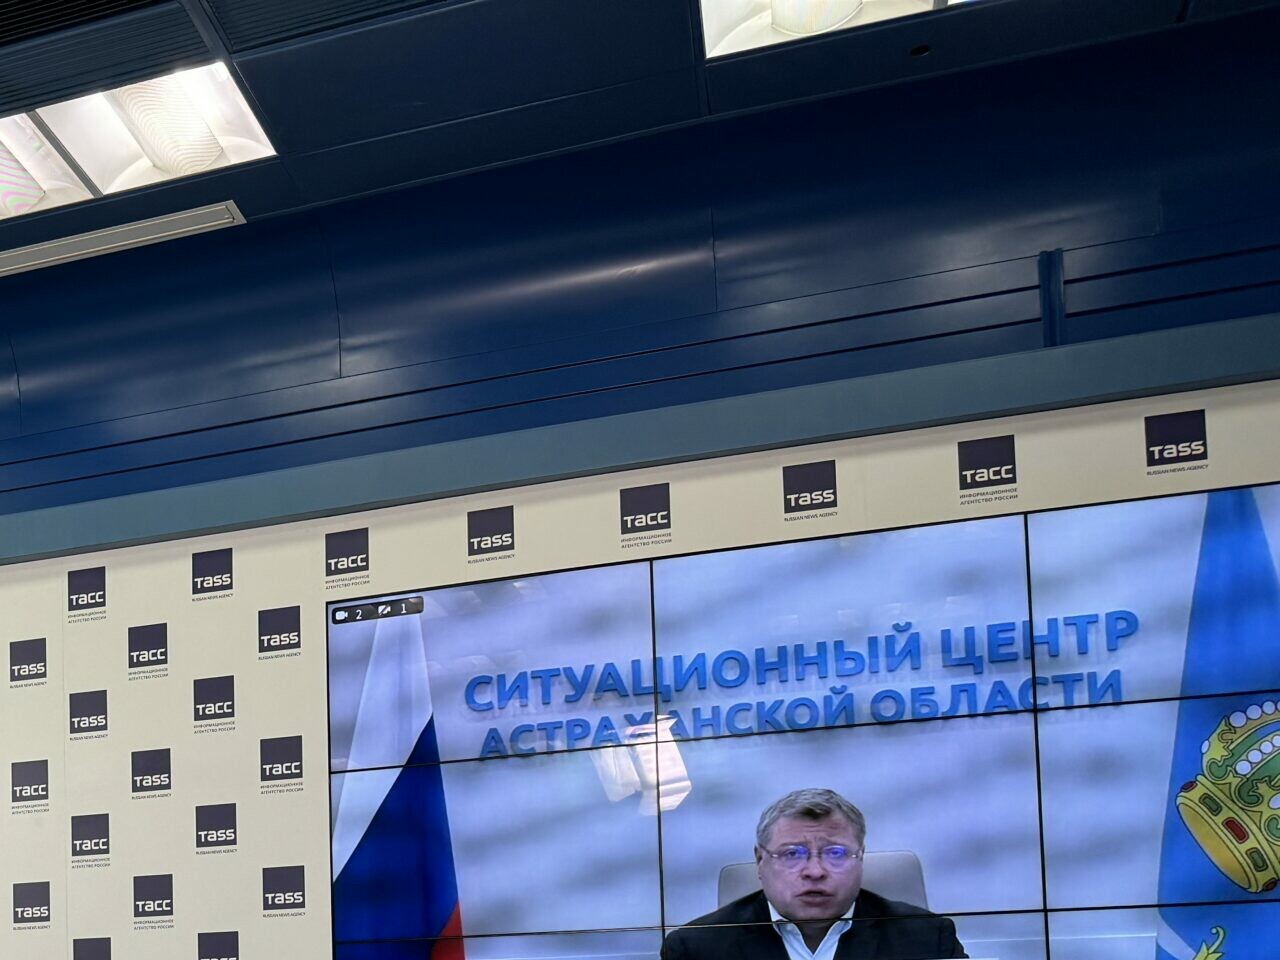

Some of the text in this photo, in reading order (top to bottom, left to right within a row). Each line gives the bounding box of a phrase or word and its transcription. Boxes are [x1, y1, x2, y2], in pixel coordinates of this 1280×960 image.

[464, 609, 1139, 713] СИТУАЦИОННЫЙ ЦЕНТР
[870, 669, 1121, 722] ОБЛАСТИ
